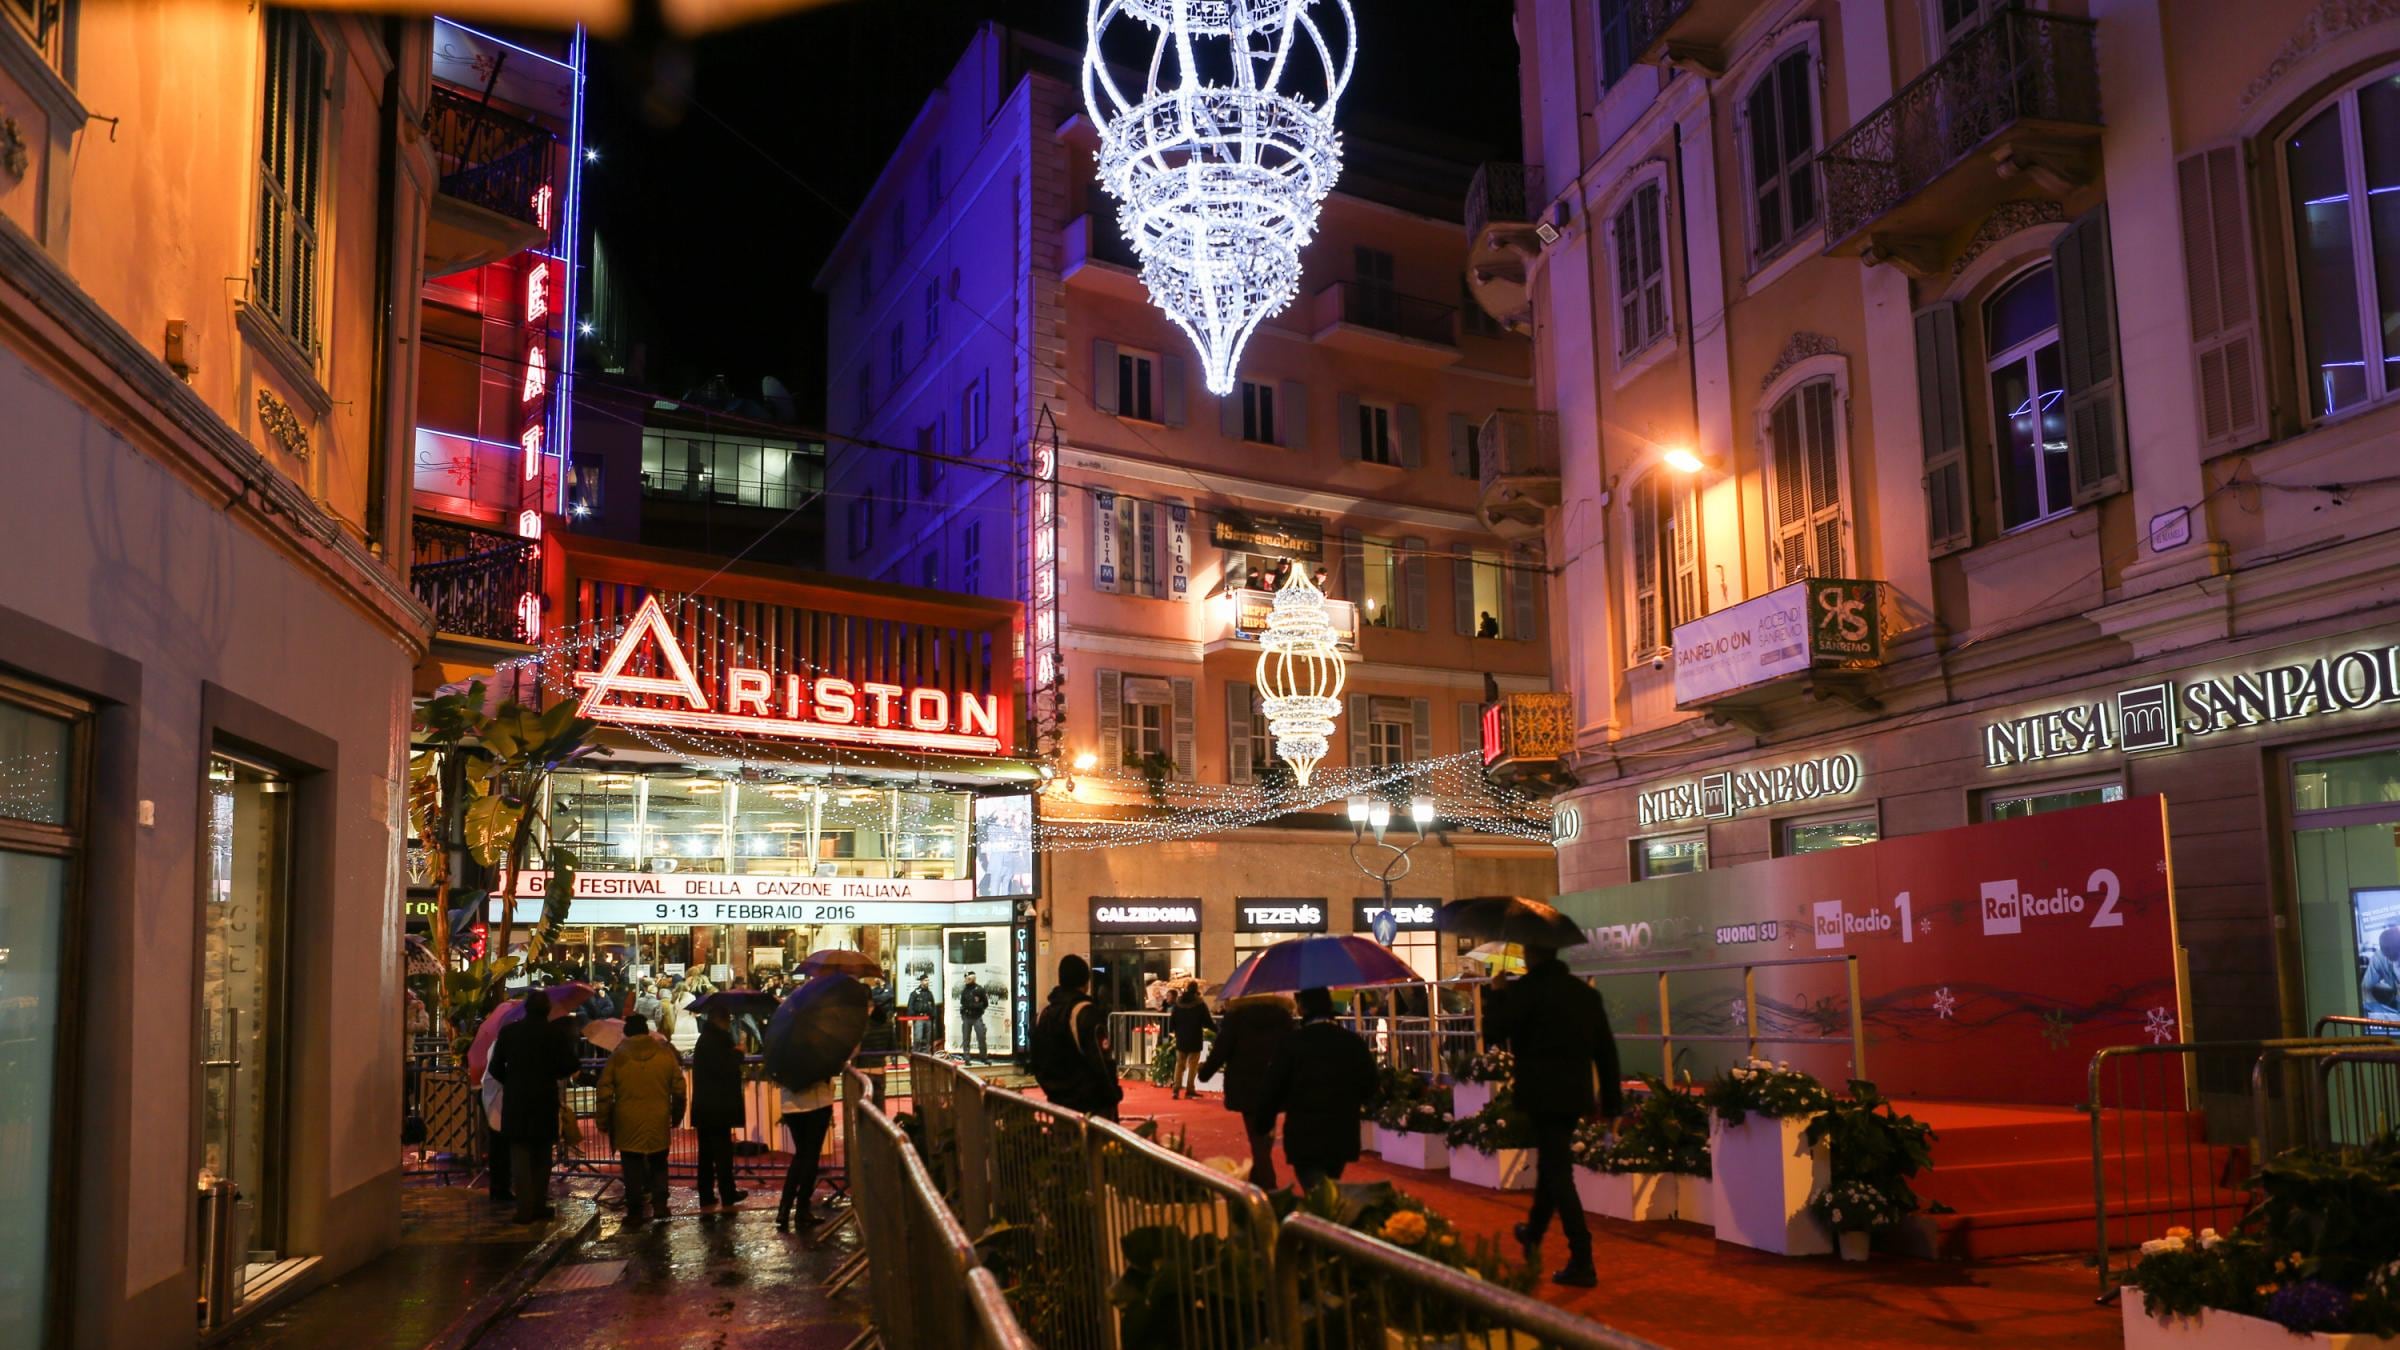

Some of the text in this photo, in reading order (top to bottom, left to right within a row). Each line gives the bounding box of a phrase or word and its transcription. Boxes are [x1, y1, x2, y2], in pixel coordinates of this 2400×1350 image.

[1174, 524, 1185, 574] MAICO
[1678, 637, 1729, 667] SANREMO
[1730, 630, 1751, 650] ON
[1819, 640, 1871, 653] SANREMO
[1981, 702, 2113, 769] INTESA
[1638, 753, 1859, 827] INTESA SANPAOLO
[579, 878, 666, 894] FESTIVAL
[685, 880, 741, 895] DELLA
[756, 881, 832, 897] CANZONE
[843, 884, 912, 898] ITALIANA
[1985, 868, 2124, 929] Rai Radio 2
[716, 904, 803, 919] FEBBRAIO
[815, 905, 856, 920] 2016
[1096, 907, 1197, 922] CALZEDONIA
[1716, 923, 1757, 944] suona
[1816, 891, 1913, 943] Rai Radio 1
[1017, 928, 1028, 997] CINEMA
